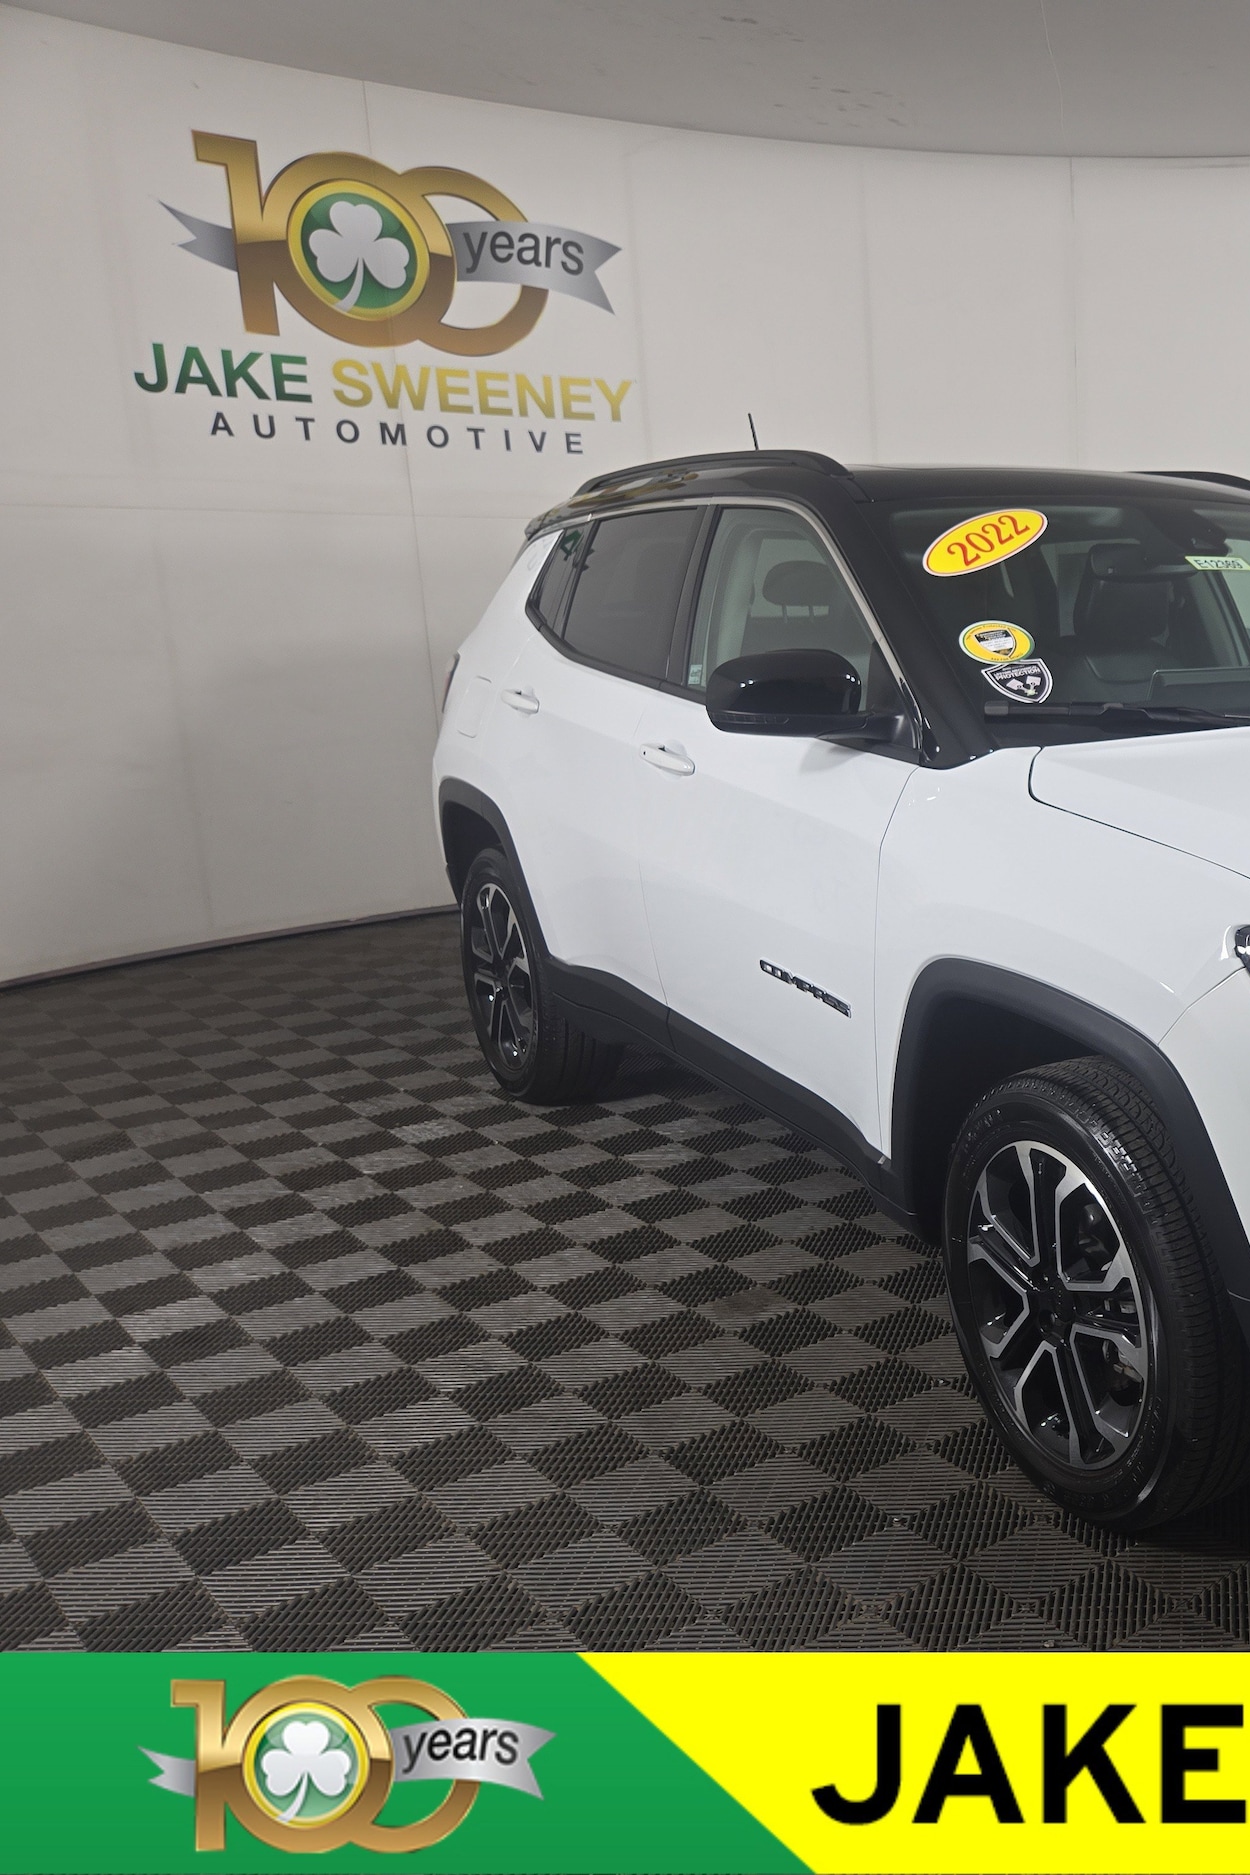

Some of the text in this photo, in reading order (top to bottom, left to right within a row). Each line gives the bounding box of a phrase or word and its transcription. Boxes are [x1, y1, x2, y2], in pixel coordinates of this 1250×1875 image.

[463, 230, 584, 275] years
[134, 342, 634, 422] JAKE SWEENEY
[210, 411, 584, 455] AUTOMOTIVE
[947, 515, 1031, 567] 2022
